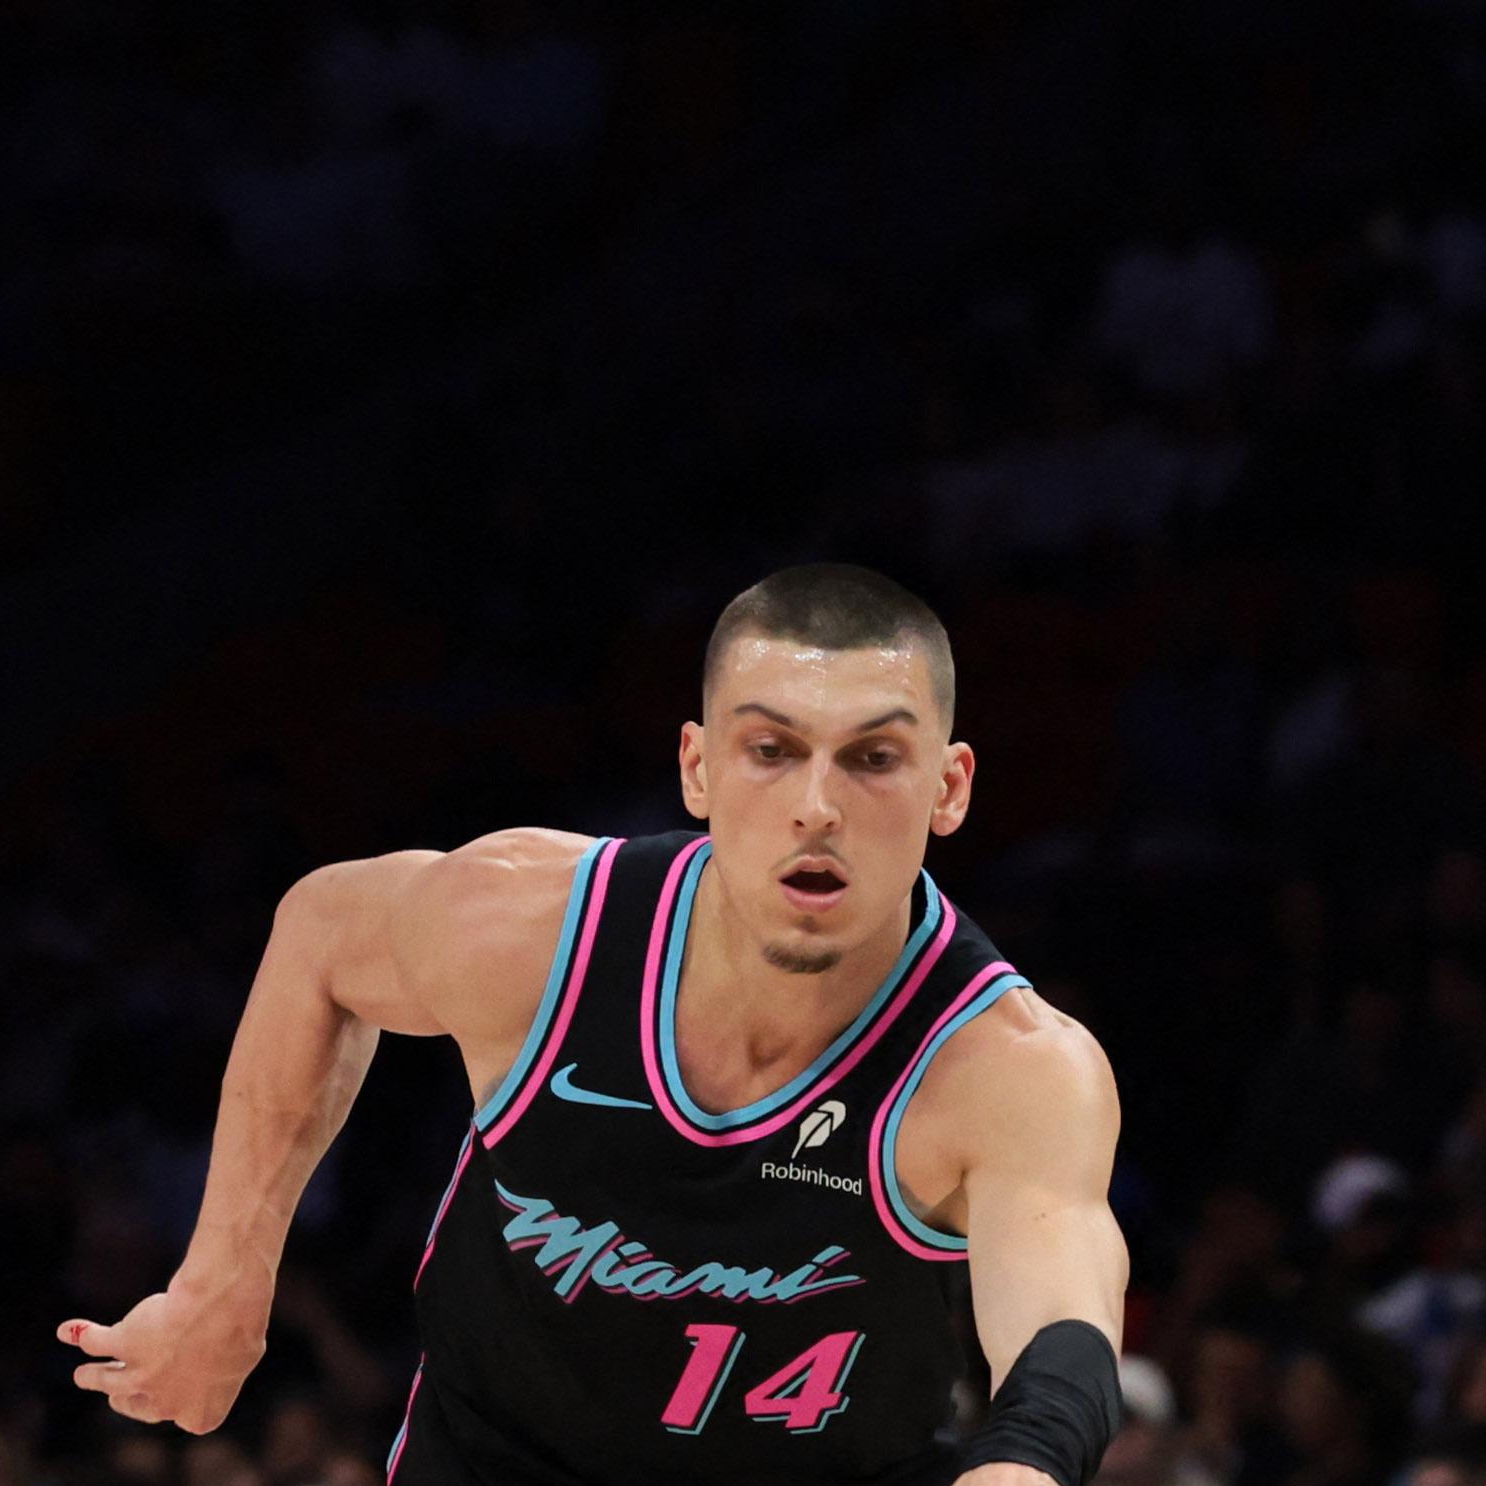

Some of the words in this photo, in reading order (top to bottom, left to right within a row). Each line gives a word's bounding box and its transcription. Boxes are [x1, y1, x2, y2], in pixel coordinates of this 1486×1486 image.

[761, 1161, 863, 1196] Robinhood
[495, 1178, 867, 1304] Miami
[660, 1323, 867, 1434] 14
